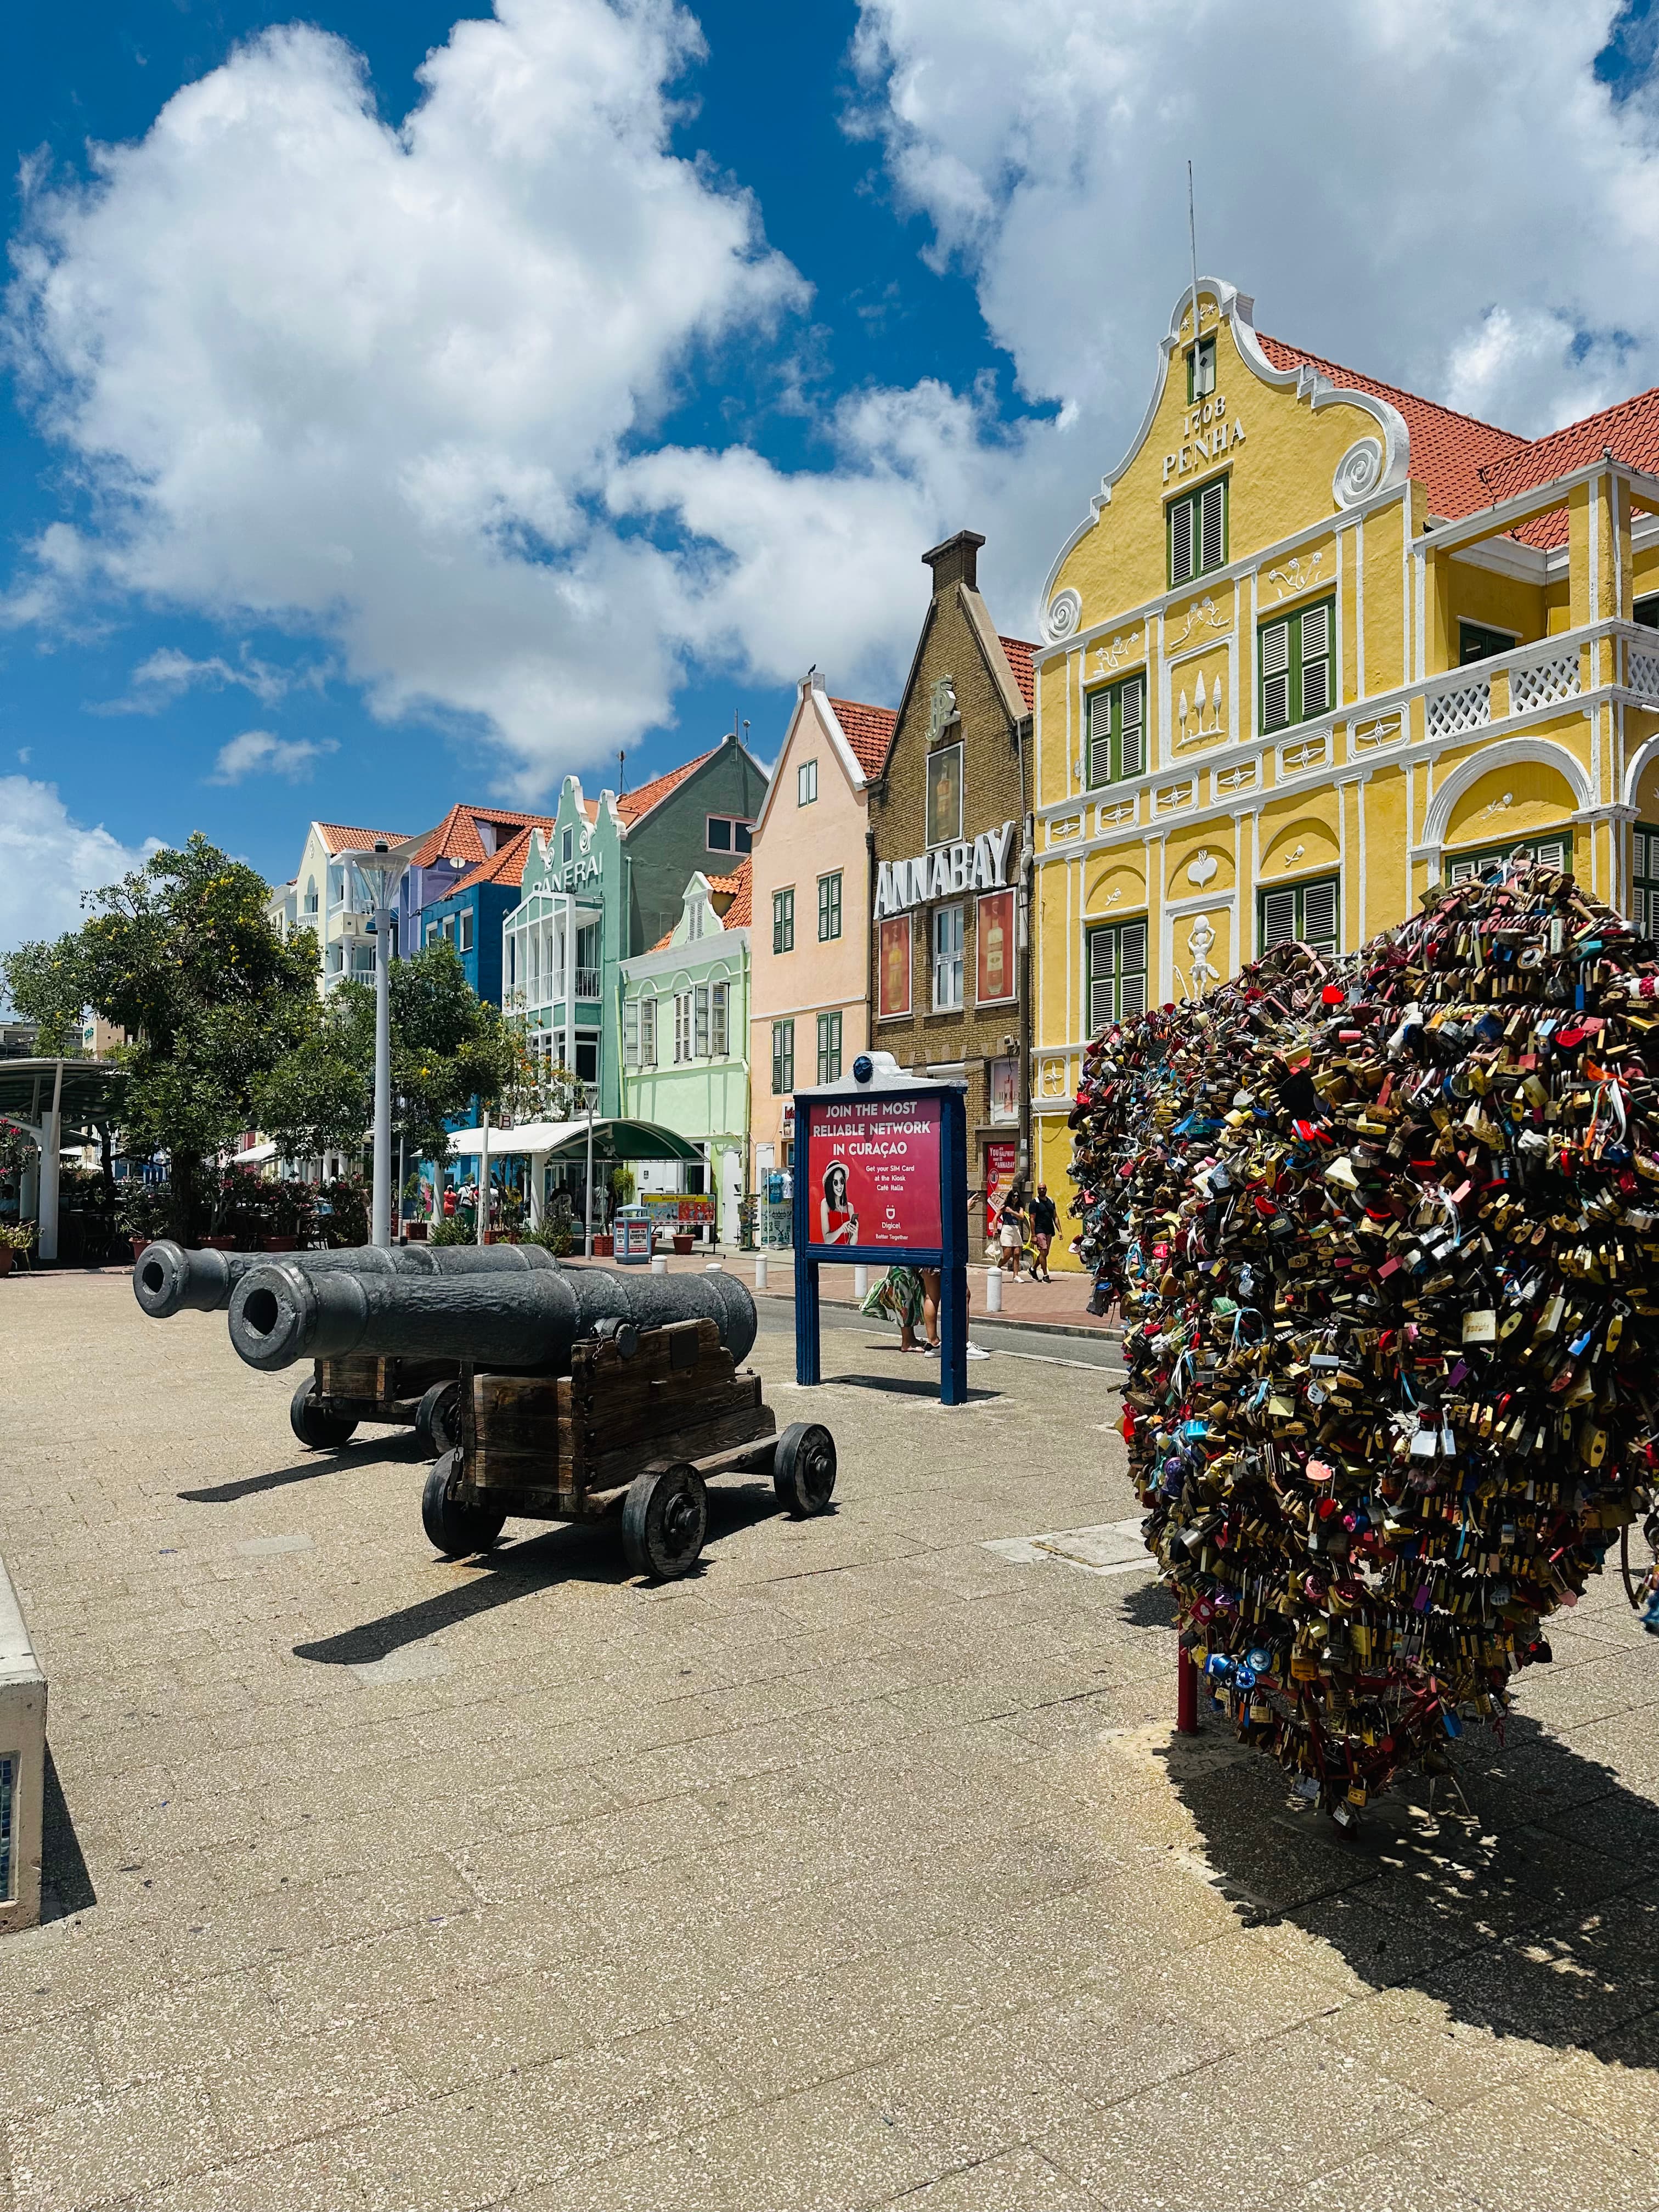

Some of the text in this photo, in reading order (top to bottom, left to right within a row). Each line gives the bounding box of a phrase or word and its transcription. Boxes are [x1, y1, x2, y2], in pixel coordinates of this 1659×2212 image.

[1183, 395, 1226, 437] 1708
[1162, 417, 1246, 483] PENHA
[532, 851, 604, 893] PANERAI
[873, 820, 1017, 920] ANNABAY
[826, 1101, 918, 1118] JOIN THE MOST
[500, 1115, 511, 1127] B
[813, 1121, 931, 1137] RELIABLE NETWORK
[833, 1141, 907, 1158] IN CURAÇAO
[882, 1222, 901, 1231] Digicel
